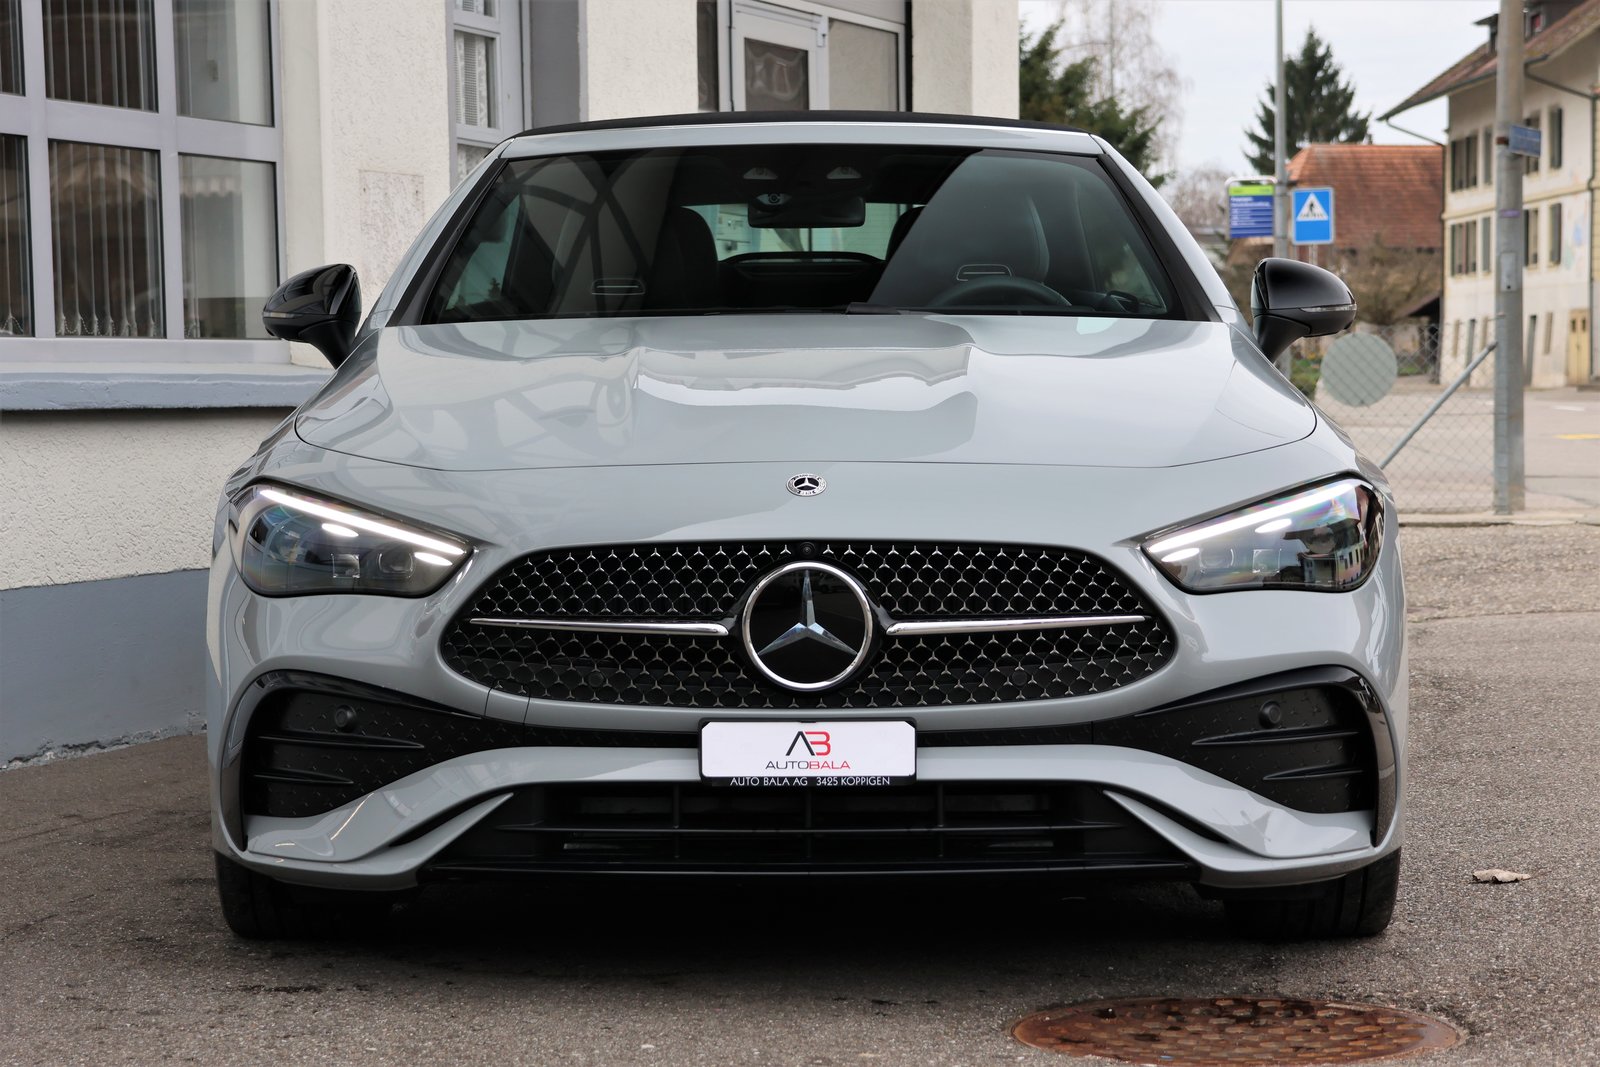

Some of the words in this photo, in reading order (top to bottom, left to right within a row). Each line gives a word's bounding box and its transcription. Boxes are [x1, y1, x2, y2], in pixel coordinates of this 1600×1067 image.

[765, 760, 850, 770] AUTOBALA
[730, 777, 760, 786] AUTO
[763, 777, 790, 786] BALA
[793, 777, 808, 786] AG
[816, 777, 838, 786] 3425
[841, 777, 890, 786] KOPPIGEN
